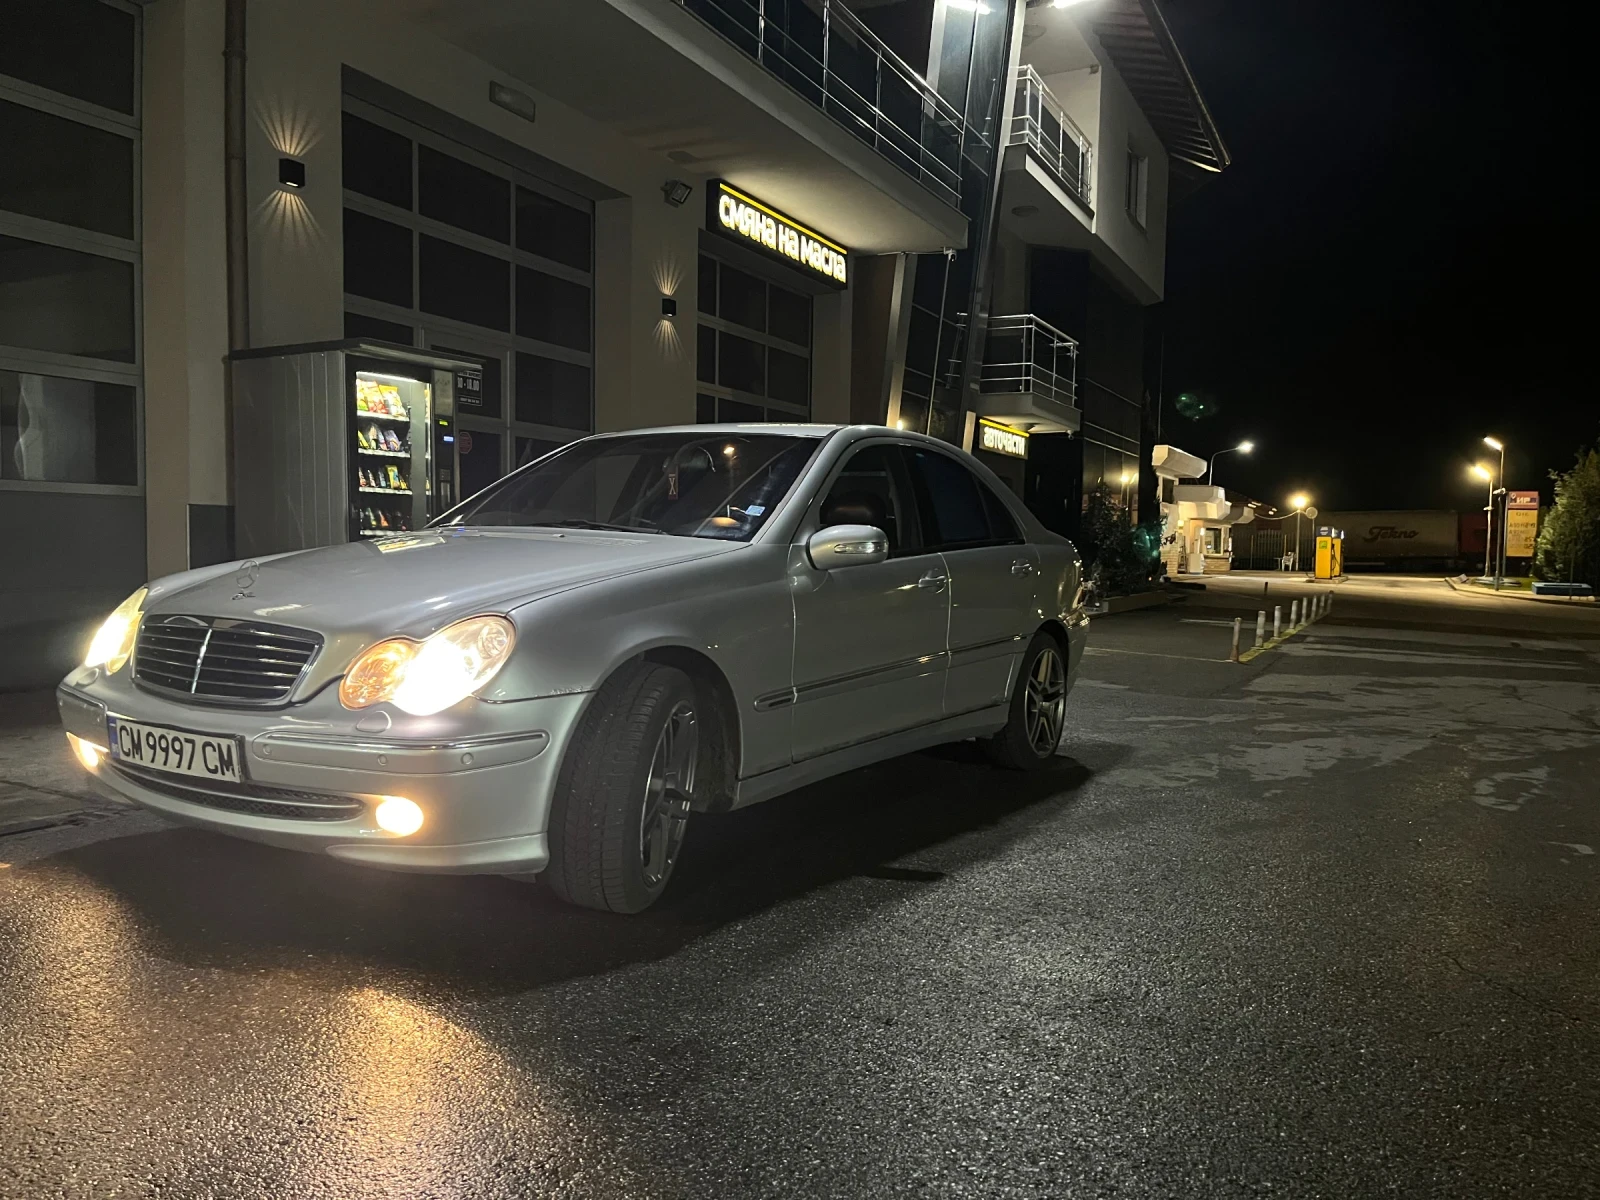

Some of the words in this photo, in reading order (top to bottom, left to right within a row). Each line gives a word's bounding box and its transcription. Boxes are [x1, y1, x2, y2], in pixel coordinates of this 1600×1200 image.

[778, 224, 799, 261] на
[801, 235, 846, 283] масла
[1362, 526, 1419, 542] Tekno
[119, 725, 143, 760] CM
[145, 731, 195, 770] 9997
[202, 741, 236, 777] CM
